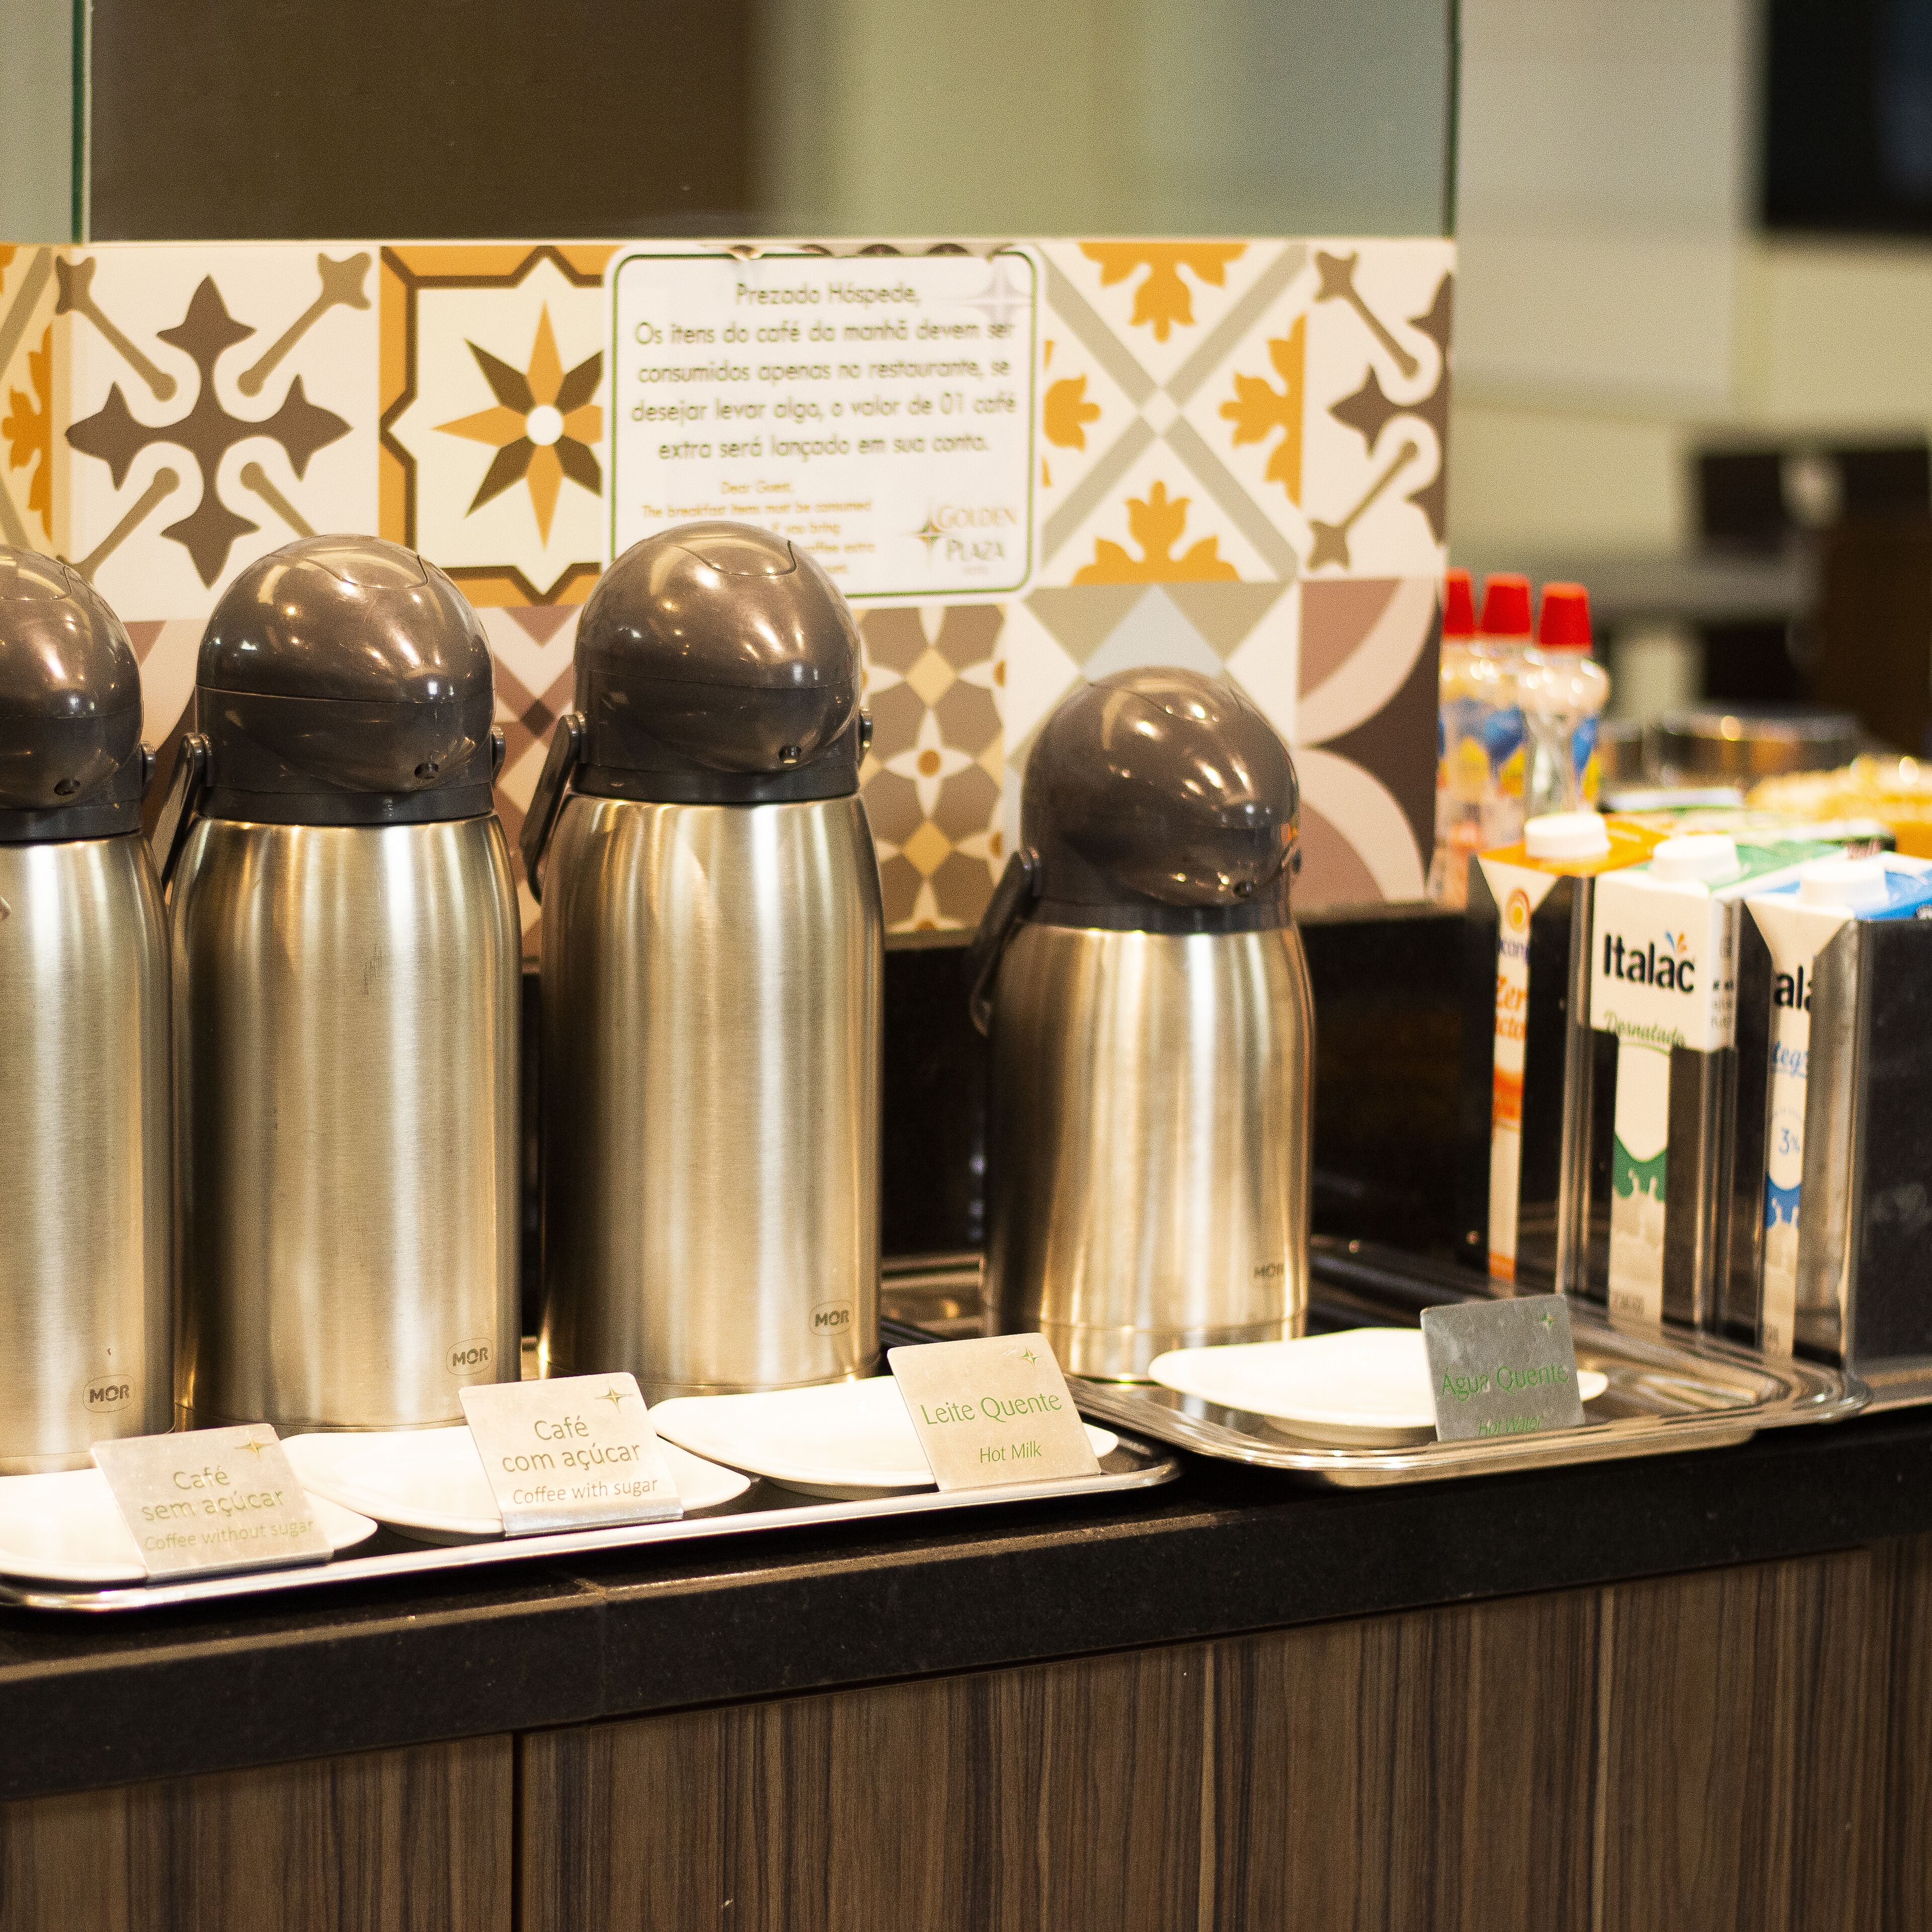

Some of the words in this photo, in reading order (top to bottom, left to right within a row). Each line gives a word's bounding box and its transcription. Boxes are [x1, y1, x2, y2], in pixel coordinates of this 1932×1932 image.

[736, 282, 820, 305] Prezado
[827, 282, 920, 308] Hóspede,
[635, 321, 663, 345] Os
[671, 323, 715, 344] itens
[722, 322, 749, 344] do
[756, 320, 800, 342] café
[809, 321, 836, 342] da
[843, 319, 908, 341] manhã
[916, 318, 979, 341] devem
[988, 323, 1014, 339] ser
[638, 359, 749, 384] consumidos
[758, 363, 830, 385] apenas
[838, 364, 860, 379] no
[869, 360, 984, 381] restaurante,
[991, 360, 1010, 377] se
[631, 399, 707, 426] desejar
[715, 399, 766, 420] levar
[773, 398, 824, 424] algo,
[830, 401, 843, 418] o
[850, 396, 900, 416] valor
[909, 394, 932, 416] de
[939, 392, 965, 414] 01
[973, 391, 1017, 414] café
[659, 441, 711, 460] extra
[720, 435, 762, 458] será
[770, 433, 850, 462] lançado
[858, 437, 886, 455] em
[894, 436, 925, 453] sua
[933, 433, 989, 453] conta.
[721, 480, 750, 495] Dear
[1604, 932, 1696, 995] Italac
[815, 1309, 849, 1328] MOR
[452, 1346, 489, 1367] MOR
[1496, 1363, 1568, 1395] Quente
[89, 1383, 130, 1404] MOR
[920, 1401, 975, 1425] Leite
[980, 1392, 1062, 1423] Quente
[534, 1415, 589, 1441] Café
[503, 1453, 555, 1473] com
[562, 1442, 640, 1470] açúcar
[980, 1445, 1006, 1463] Hot
[1012, 1440, 1042, 1460] Milk
[173, 1465, 231, 1491] Café
[513, 1487, 566, 1505] Coffee
[572, 1481, 608, 1499] with
[614, 1478, 658, 1498] sugar
[141, 1501, 196, 1522] sem
[203, 1489, 284, 1518] açúcar
[144, 1533, 197, 1552] Coffee
[201, 1523, 266, 1545] without
[270, 1519, 314, 1540] sugar
